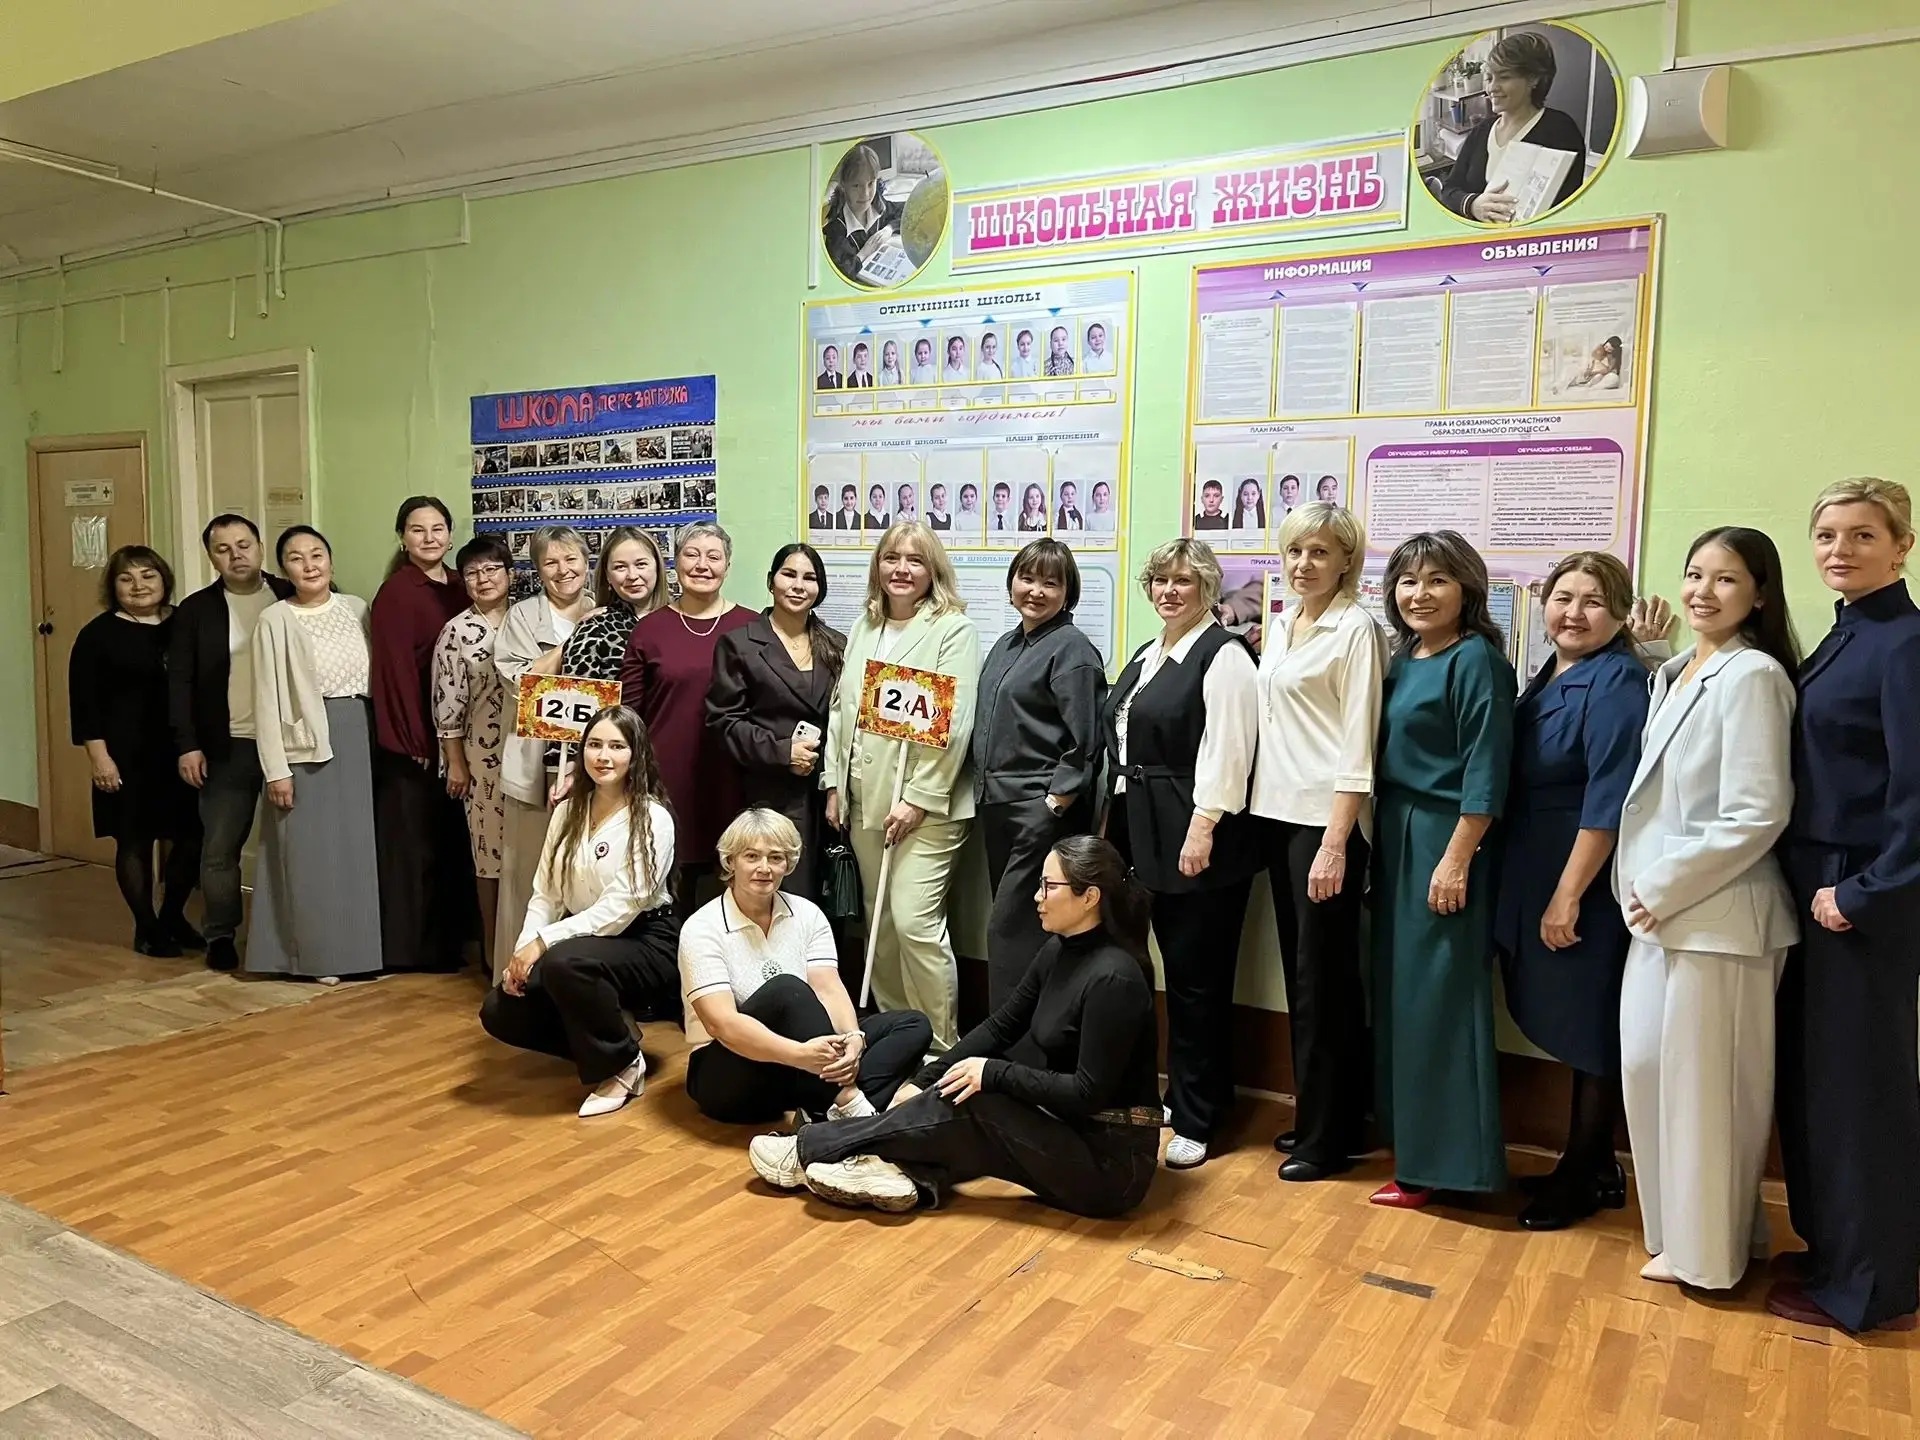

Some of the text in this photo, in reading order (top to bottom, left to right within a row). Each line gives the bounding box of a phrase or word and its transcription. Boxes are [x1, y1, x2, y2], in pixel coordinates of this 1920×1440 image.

[969, 155, 1384, 251] ШКОЛЬНАЯ ЖИЗНЬ
[1481, 236, 1599, 261] ОБЪЯВЛЕНИЯ
[1263, 258, 1372, 281] ИНФОРМАЦИЯ
[879, 291, 1041, 315] ОТЛИЧНИКИ ШКОЛЫ
[497, 391, 595, 430] ШКОЛА
[635, 385, 689, 409] ЗАГРУЗКА
[1269, 425, 1295, 433] РАБОТЫ
[1424, 420, 1448, 428] ПРАВА
[1455, 418, 1511, 427] ОБЯЗАННОСТИ
[1511, 416, 1562, 425] УЧАСТНИКОВ
[1432, 425, 1551, 436] ОБРАЗОВАТЕЛЬНОГО ПРОЦЕССА
[914, 438, 948, 446] ШКОЛЫ
[1250, 558, 1280, 566] ПРИКАЗЫ
